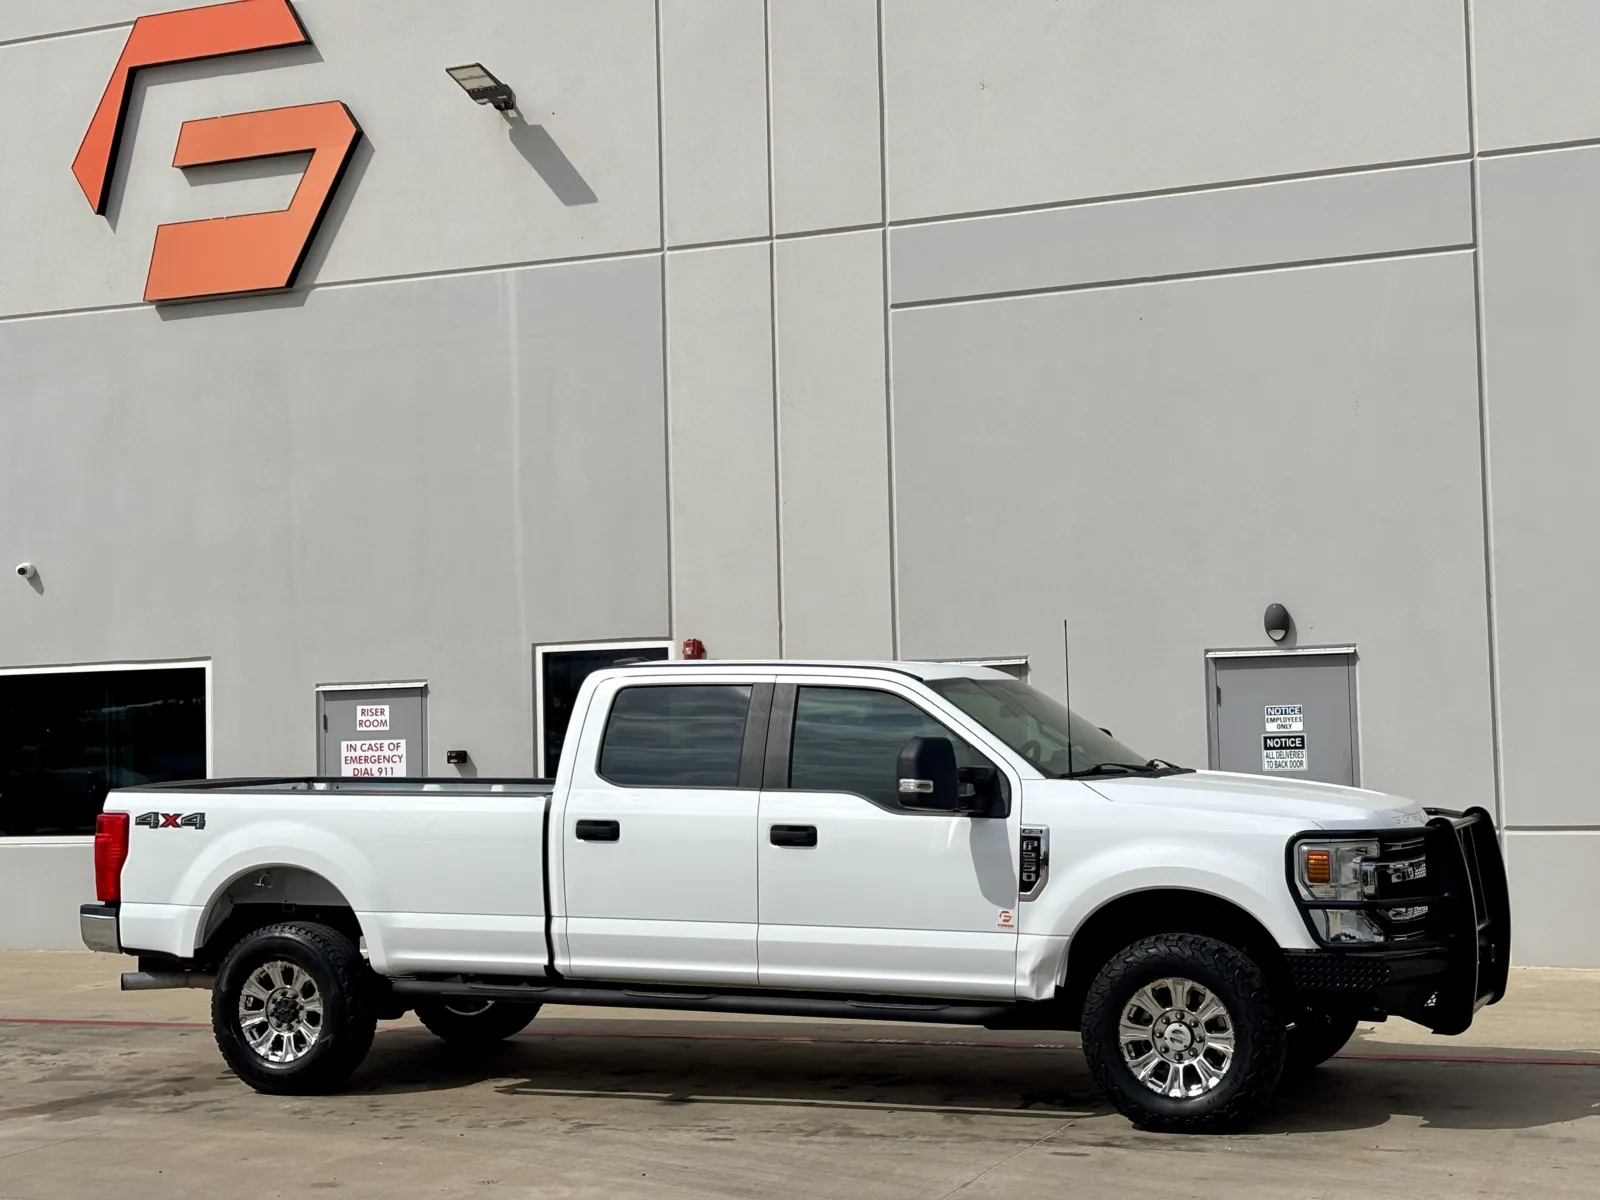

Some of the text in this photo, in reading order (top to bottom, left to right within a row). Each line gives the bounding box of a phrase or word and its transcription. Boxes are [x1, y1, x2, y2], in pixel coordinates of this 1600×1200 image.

[361, 708, 386, 717] RISER
[1267, 707, 1300, 715] NOTICE
[358, 719, 388, 728] ROOM
[346, 742, 401, 752] IN CASE OF
[1266, 738, 1302, 748] NOTICE
[344, 754, 404, 765] EMERGENCY
[1265, 750, 1304, 760] ALL DELIVERIES
[1266, 760, 1304, 769] TO BACK DOOR
[352, 767, 394, 777] DIAL 911
